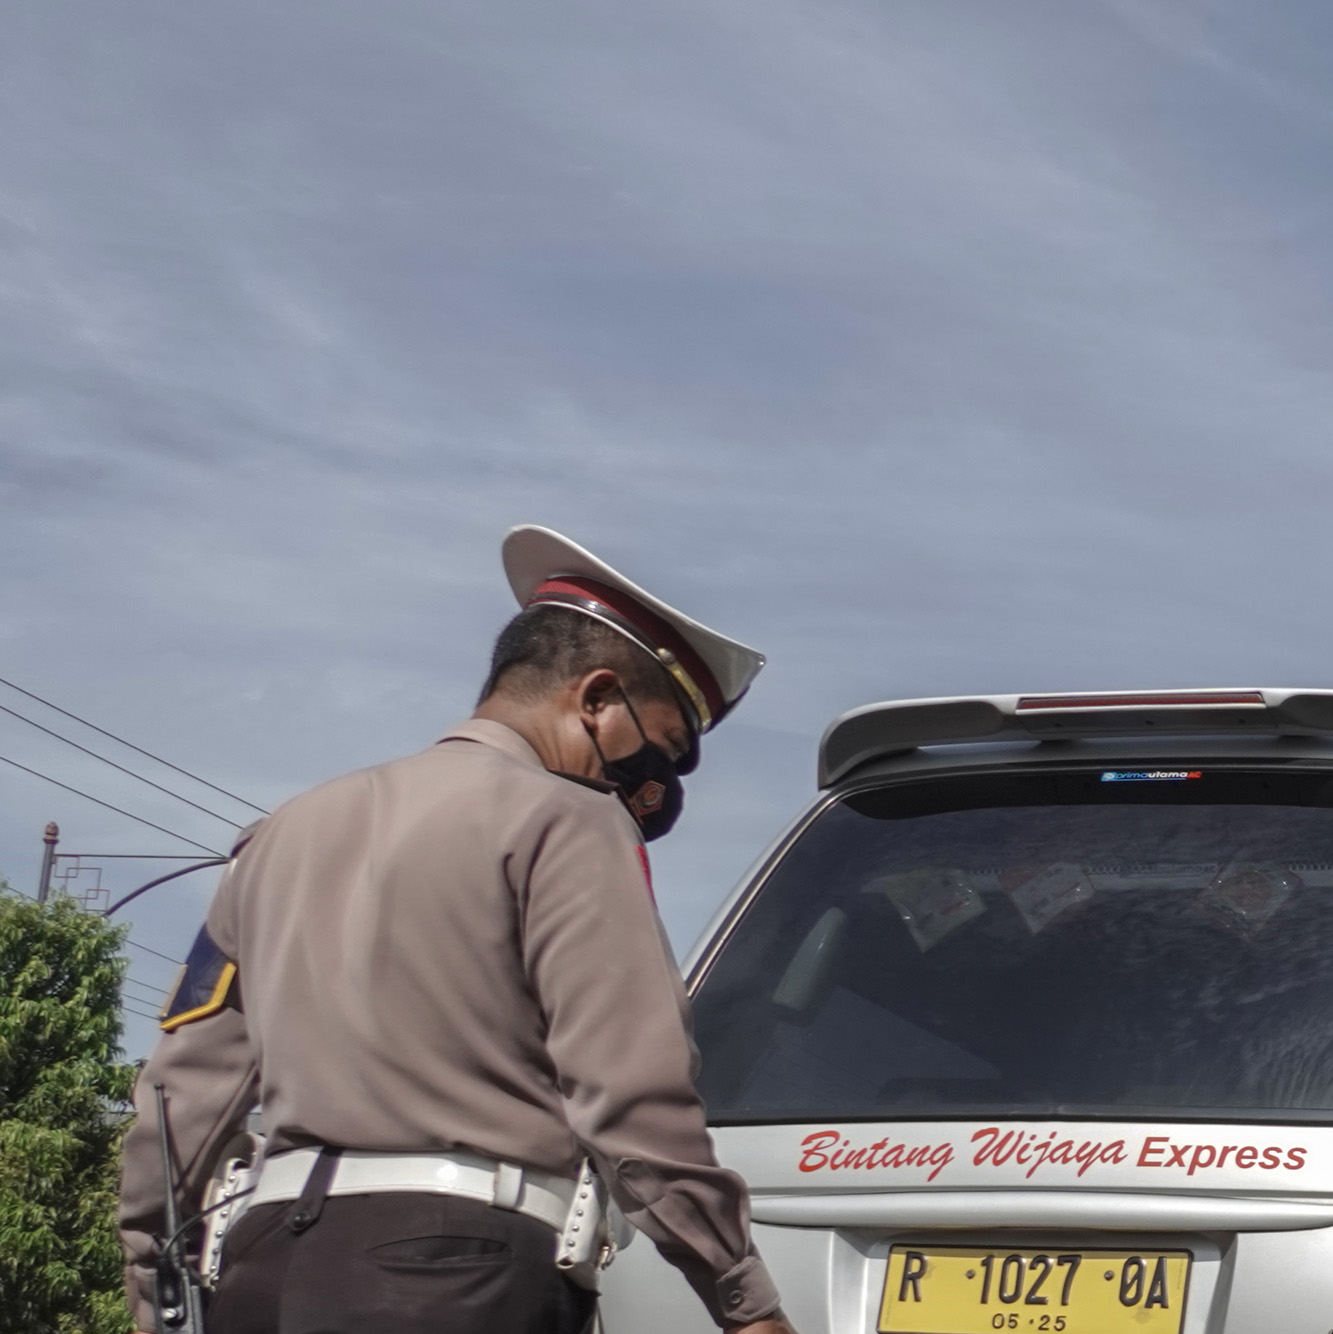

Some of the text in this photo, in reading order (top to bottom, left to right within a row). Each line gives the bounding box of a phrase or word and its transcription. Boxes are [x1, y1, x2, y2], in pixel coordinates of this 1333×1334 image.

[798, 1126, 1308, 1182] Bintang Wijaya Express
[898, 1251, 928, 1303] R
[979, 1253, 1082, 1307] 1027
